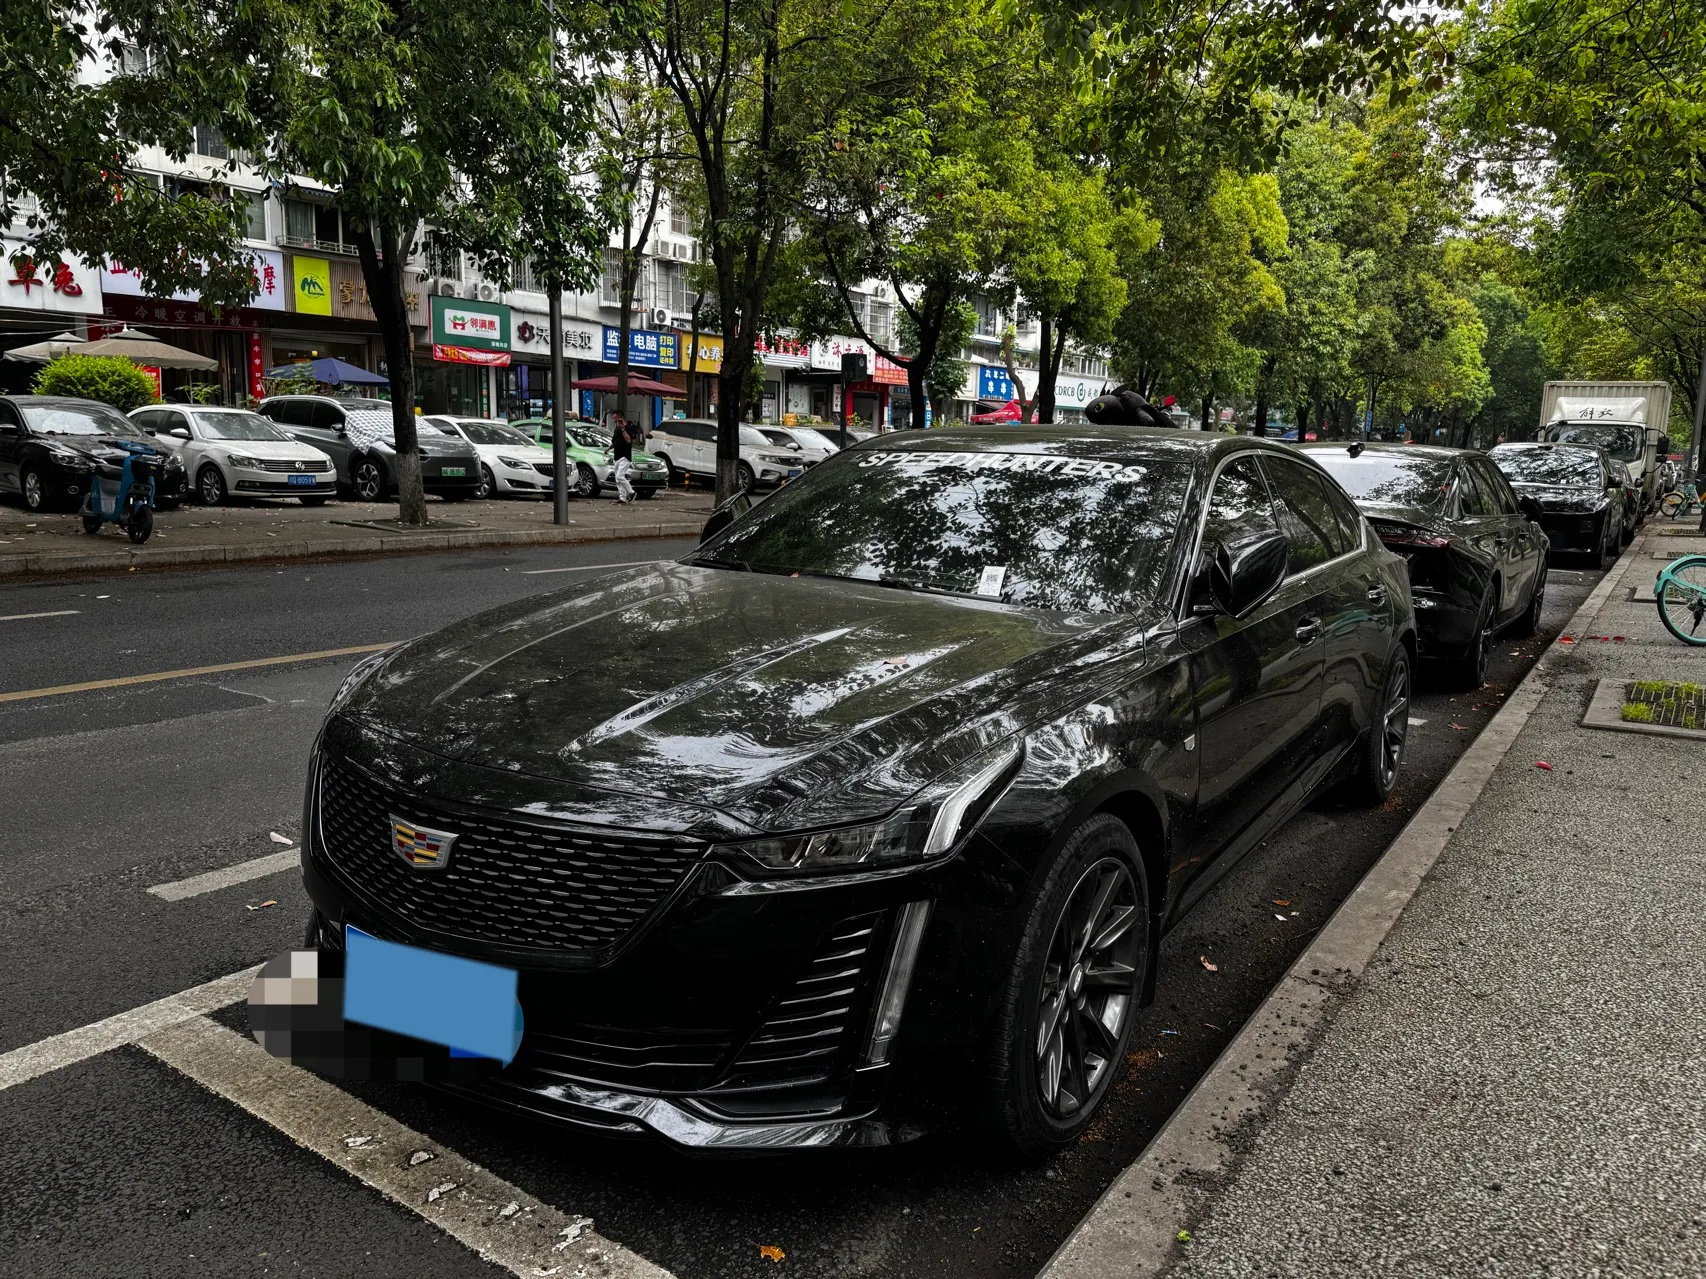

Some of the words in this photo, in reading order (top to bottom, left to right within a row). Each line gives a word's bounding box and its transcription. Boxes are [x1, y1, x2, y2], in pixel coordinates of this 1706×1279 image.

[135, 305, 242, 327] 冷暖空调开放
[470, 317, 497, 331] 邻满惠
[536, 326, 593, 350] 天美妆
[606, 329, 658, 352] 监电脑
[659, 335, 674, 346] 打印
[659, 346, 674, 358] 复印
[858, 452, 1148, 482] SPEEDHUNTERS
